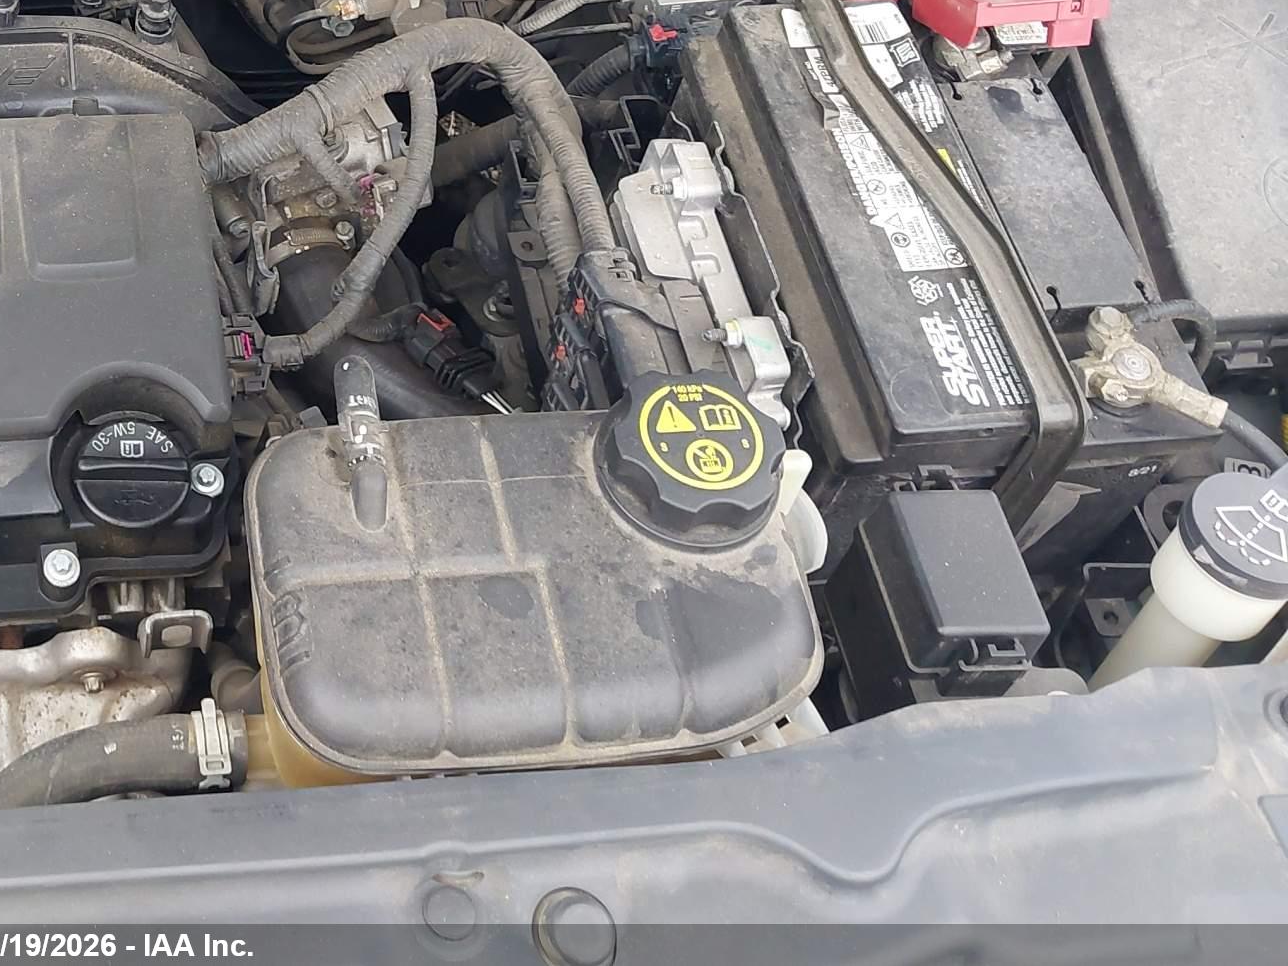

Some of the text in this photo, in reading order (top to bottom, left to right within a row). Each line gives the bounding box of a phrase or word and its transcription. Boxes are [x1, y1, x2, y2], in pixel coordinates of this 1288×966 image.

[920, 317, 960, 396] SUPER
[934, 317, 990, 407] START
[91, 421, 174, 453] SAE 5W-30
